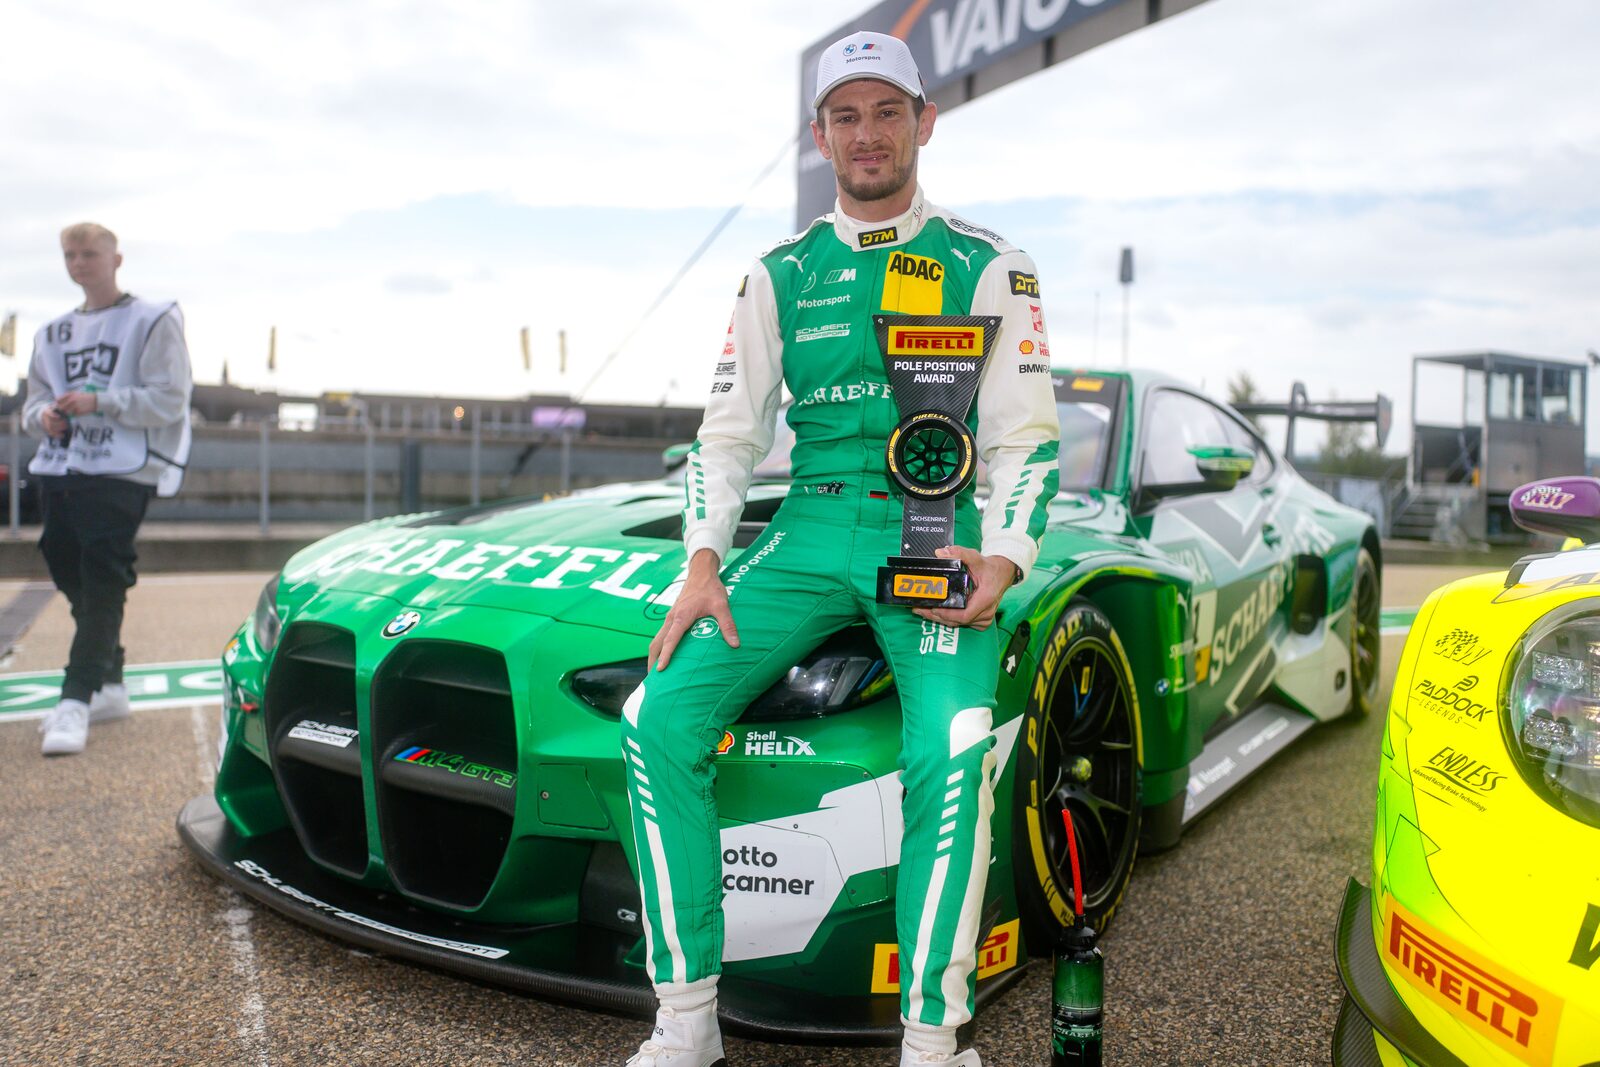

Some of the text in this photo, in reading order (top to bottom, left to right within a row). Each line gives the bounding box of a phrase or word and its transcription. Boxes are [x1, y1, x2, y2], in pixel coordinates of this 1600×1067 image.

[845, 56, 881, 64] Motorsport
[862, 229, 895, 245] DTM
[889, 253, 943, 282] ADAC
[797, 294, 851, 309] Motorsport
[45, 323, 72, 343] 16
[795, 323, 851, 336] SCHUBERT
[895, 331, 976, 350] PIRELLI
[894, 361, 976, 372] POLE POSITION
[913, 374, 955, 384] AWARD
[912, 413, 949, 422] PIRELLI
[898, 578, 944, 595] DTM
[1034, 612, 1082, 712] ZERO
[1415, 680, 1494, 722] PADDOCK
[1419, 699, 1463, 724] LEGENDS
[746, 731, 776, 740] Shell
[745, 736, 816, 756] HELIX
[461, 763, 517, 788] GT3
[1428, 746, 1508, 792] ENDLESS
[1413, 768, 1487, 812] Advanced Racing Brake Technology
[722, 845, 778, 868] otto
[722, 874, 815, 896] canner
[1389, 911, 1540, 1048] PIRELLI
